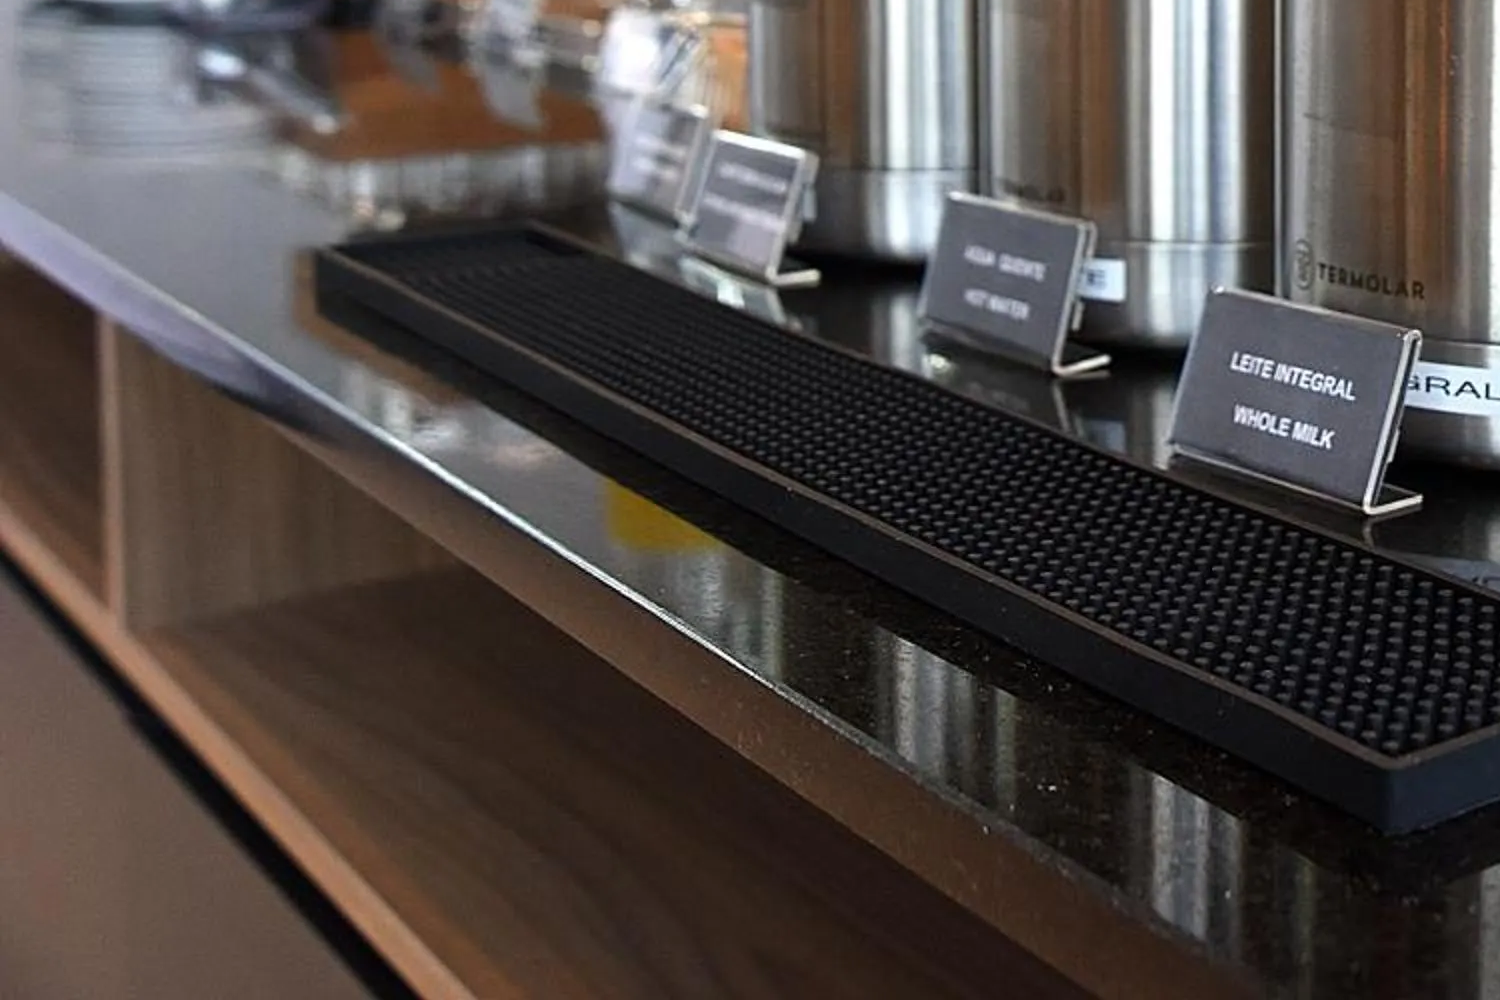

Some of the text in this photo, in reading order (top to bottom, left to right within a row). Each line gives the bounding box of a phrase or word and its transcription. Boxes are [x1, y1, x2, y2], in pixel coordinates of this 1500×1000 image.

[1317, 261, 1426, 300] TERMOLAR
[1230, 351, 1356, 402] LEITE INTEGRAL
[1233, 404, 1336, 450] WHOLE MILK
